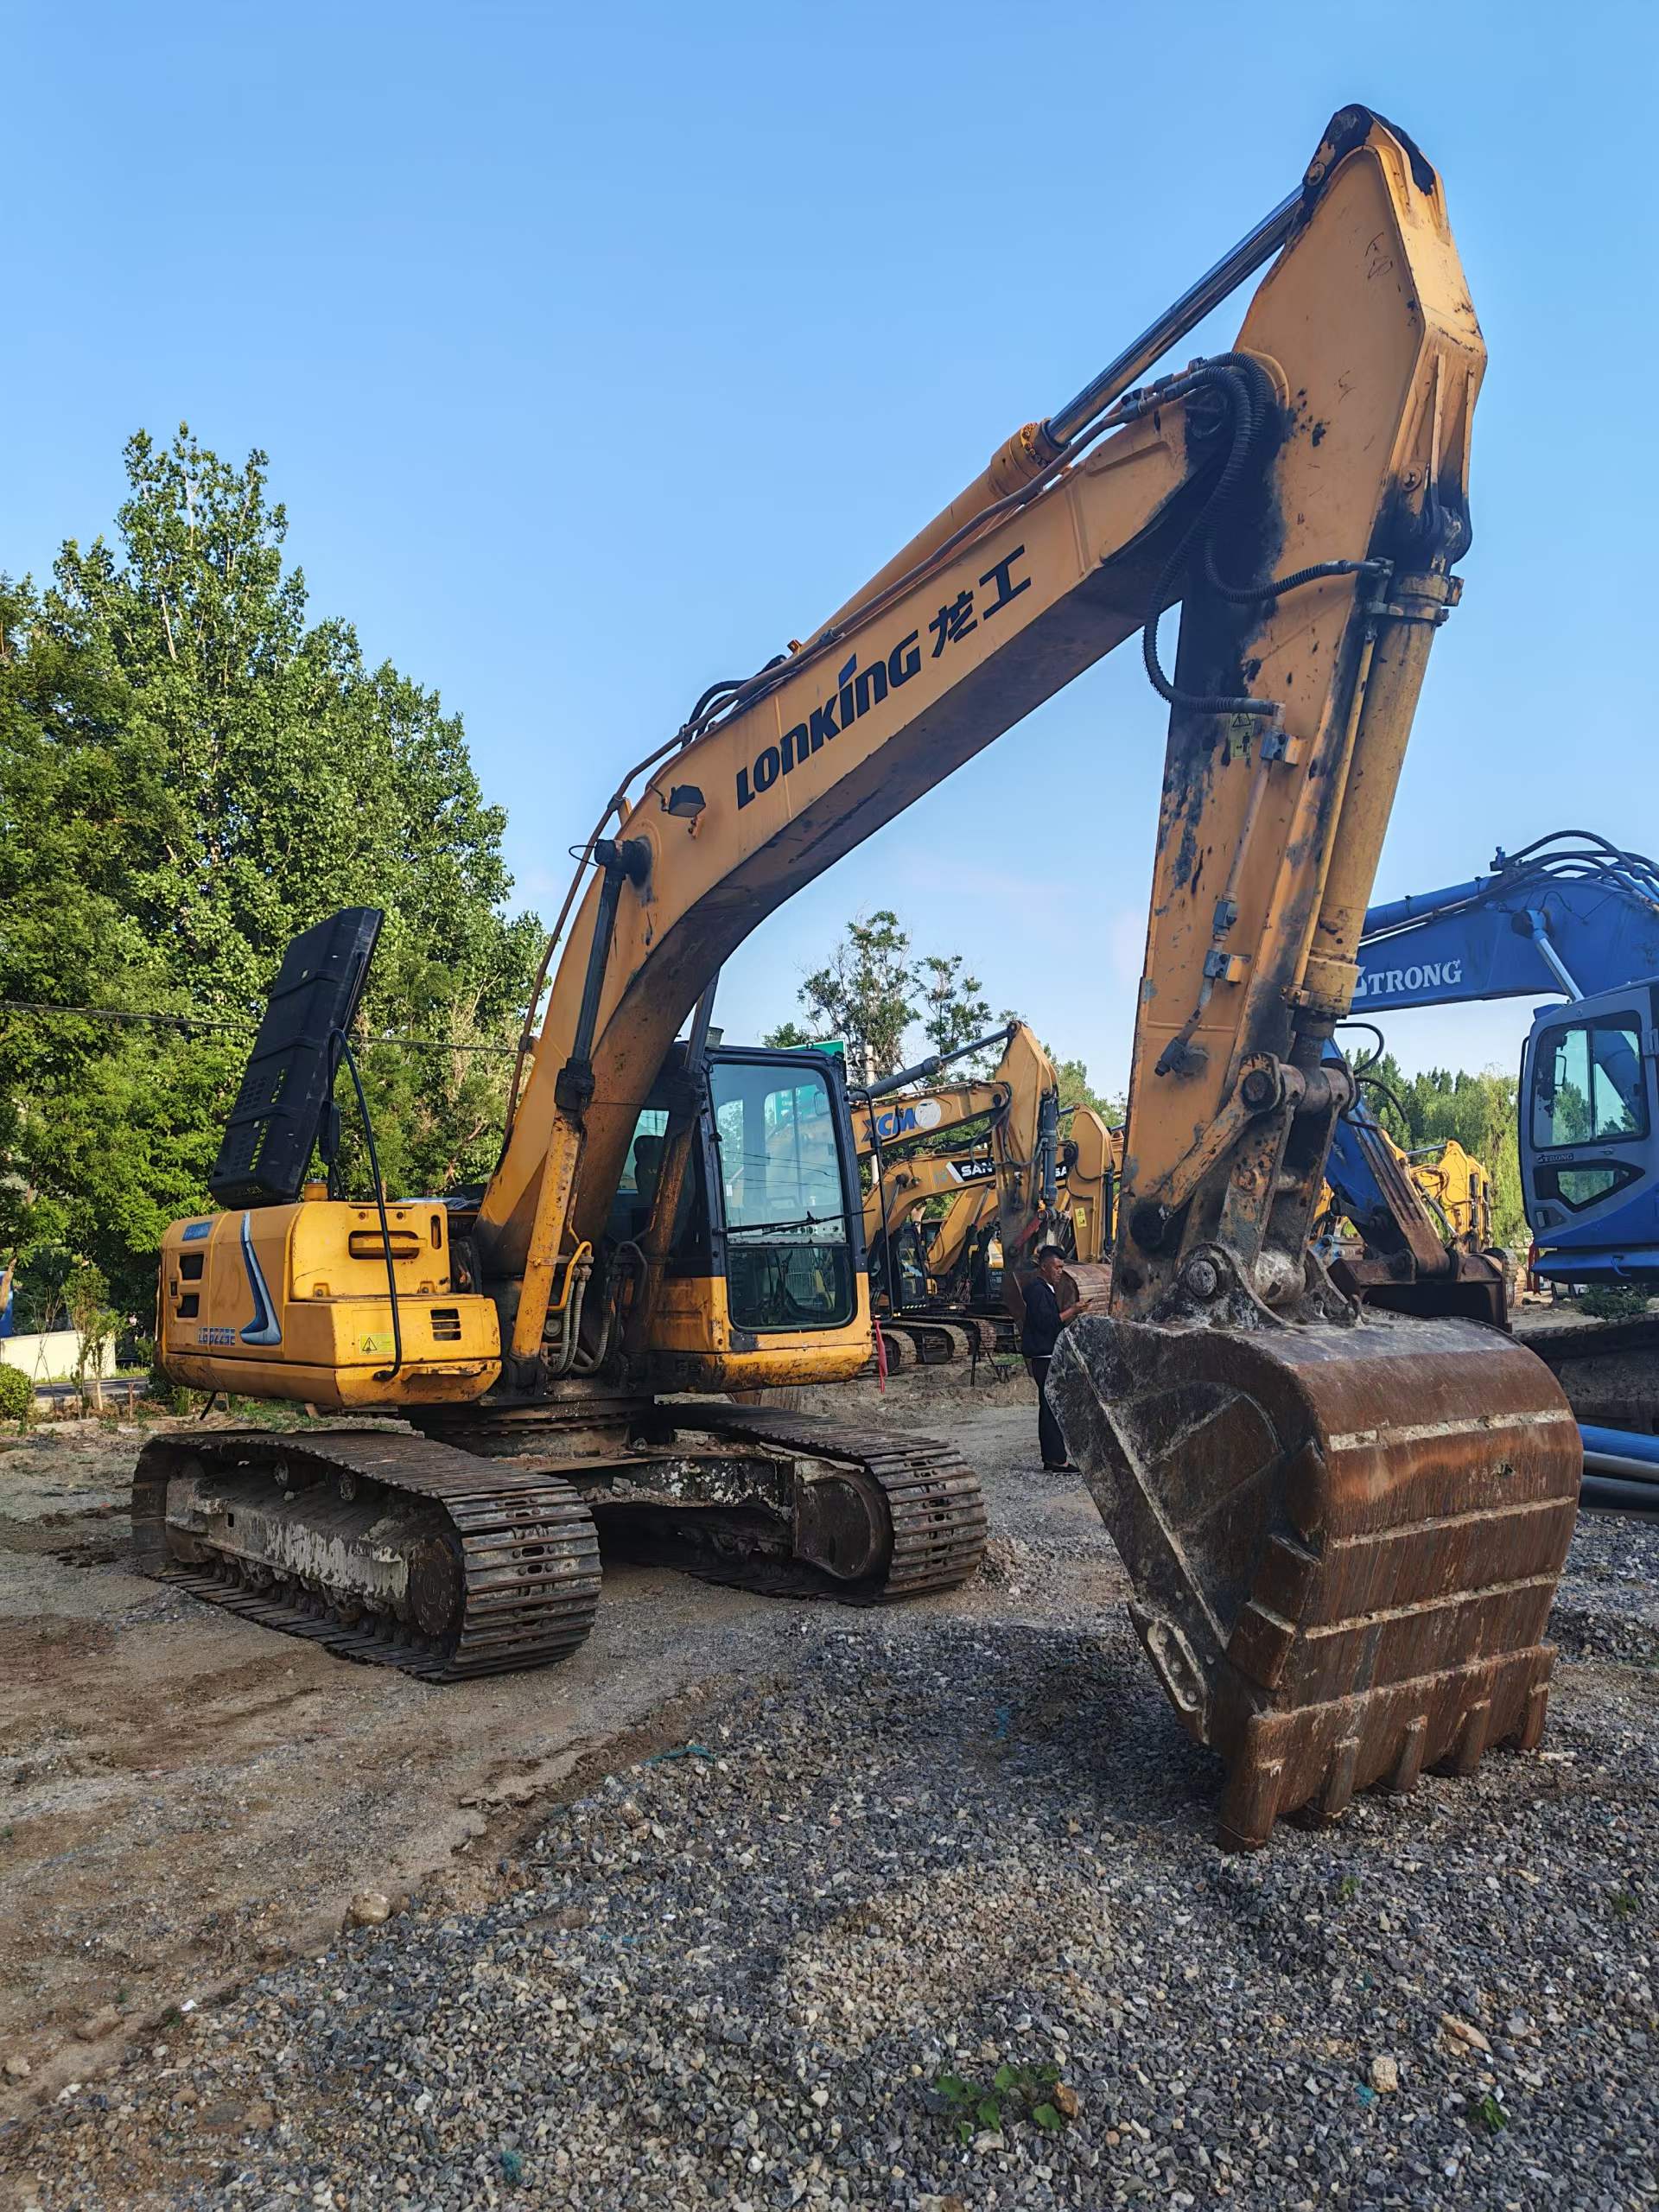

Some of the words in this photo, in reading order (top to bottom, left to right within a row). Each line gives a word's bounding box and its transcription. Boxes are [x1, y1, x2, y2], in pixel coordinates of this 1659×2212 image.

[929, 544, 1032, 658] 龙工
[861, 1107, 918, 1142] XCM
[961, 1160, 995, 1177] SAN
